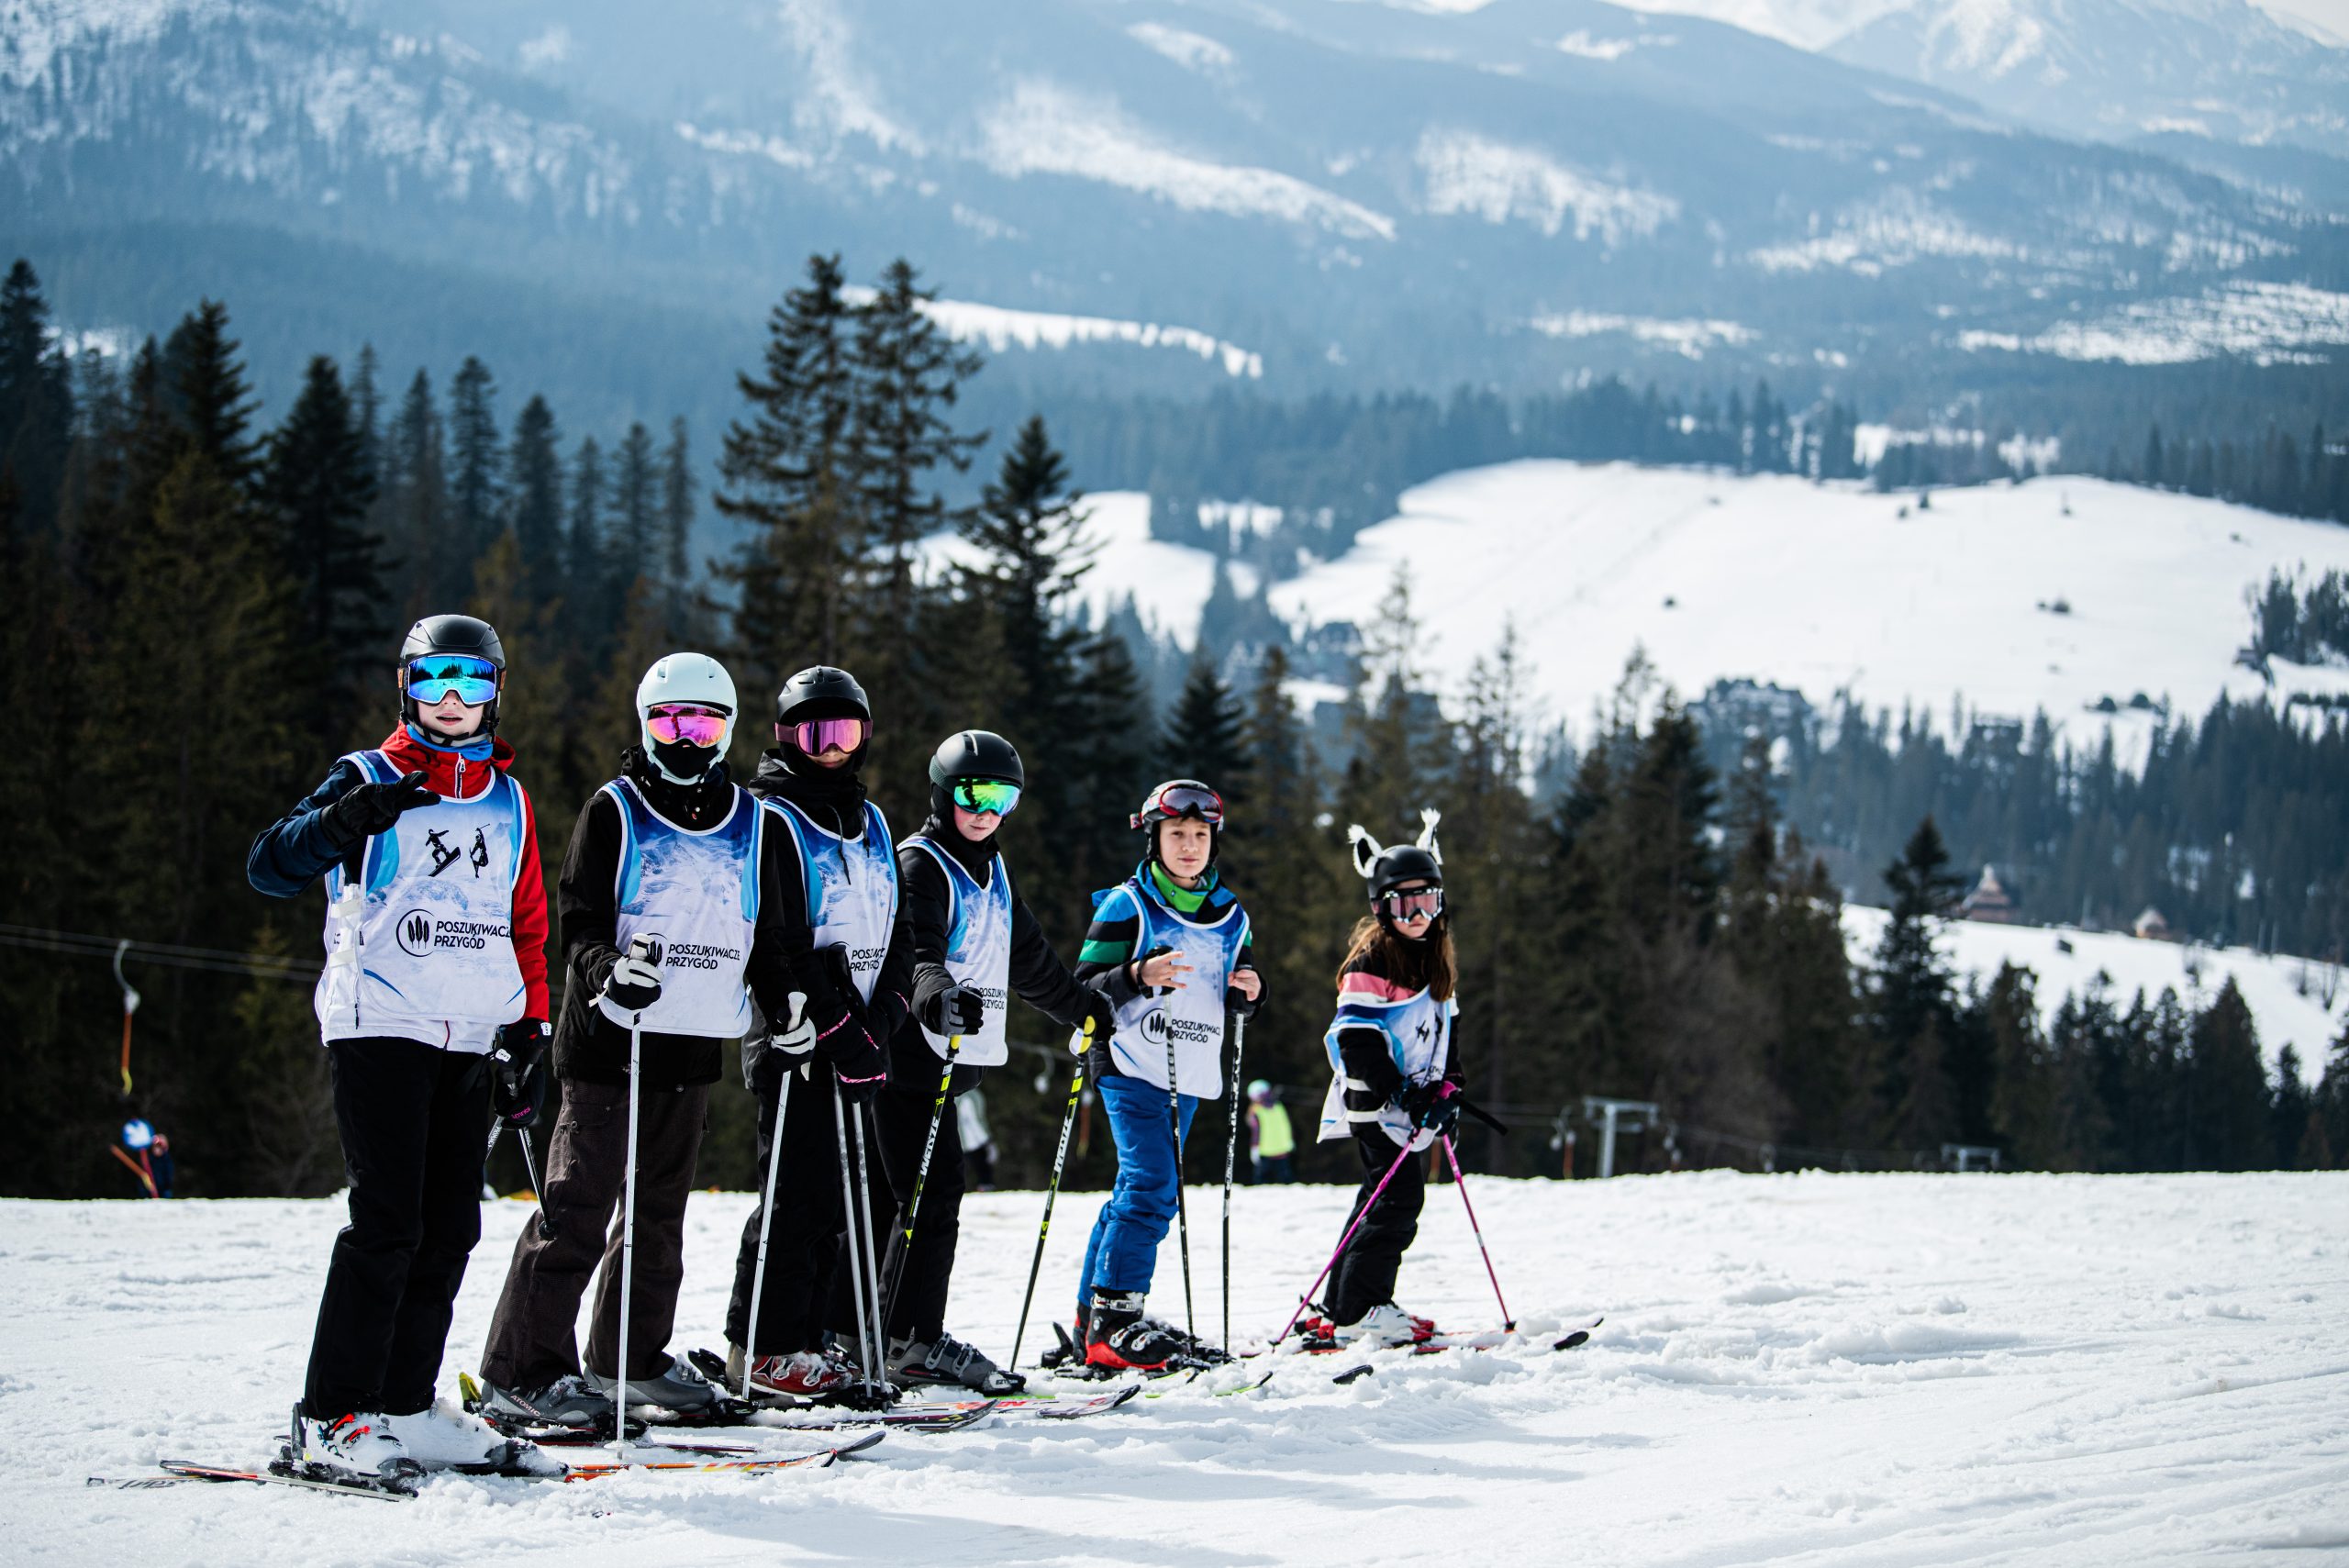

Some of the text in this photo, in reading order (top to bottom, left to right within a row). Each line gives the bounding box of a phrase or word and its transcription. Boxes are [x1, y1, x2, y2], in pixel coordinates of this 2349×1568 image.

[434, 935, 485, 950] PRZYGÓD
[668, 943, 740, 961] POSZUKIWACZE
[665, 955, 718, 970] PRZYGÓD
[510, 1395, 541, 1417] ATOMIC
